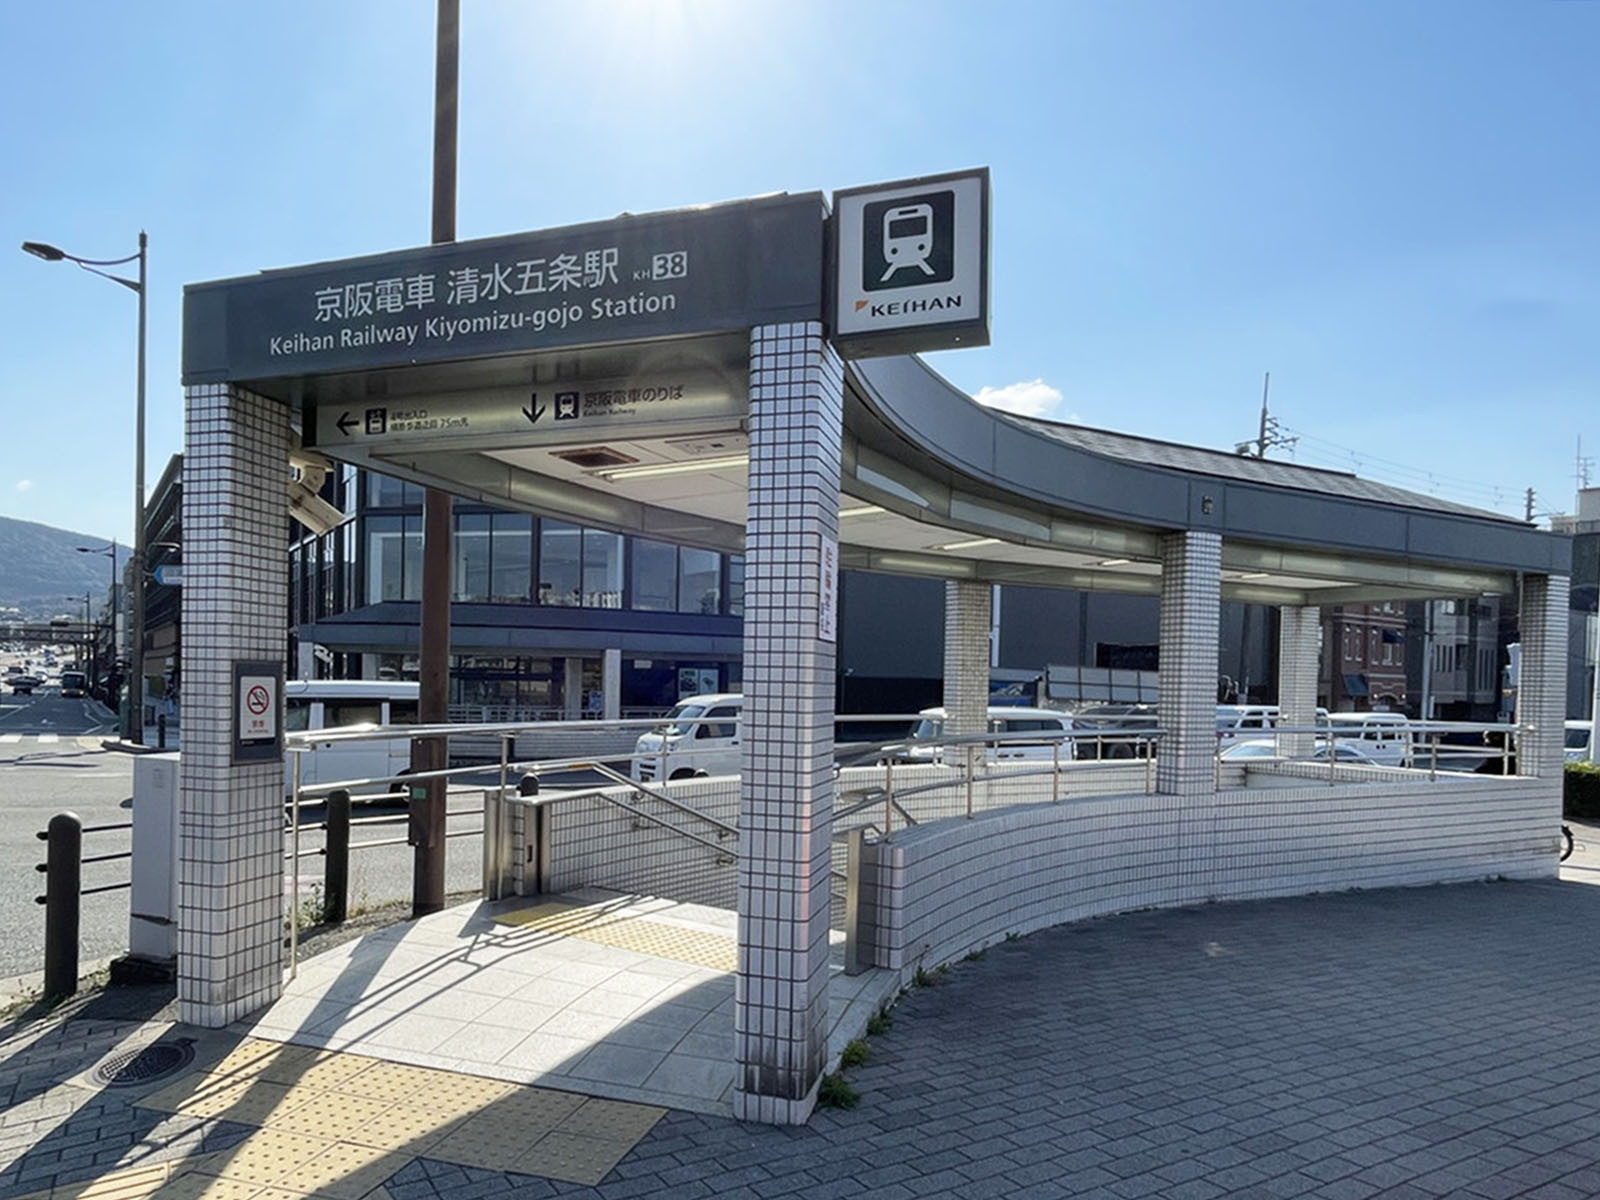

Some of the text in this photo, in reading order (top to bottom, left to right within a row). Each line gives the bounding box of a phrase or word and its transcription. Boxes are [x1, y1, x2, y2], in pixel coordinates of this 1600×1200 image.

[314, 275, 435, 323] 京阪電車
[446, 247, 619, 305] 清水五条駅
[655, 253, 685, 278] 38
[871, 295, 962, 317] KEIHAN
[270, 290, 677, 356] Keihan Railway Kiyomizu-gojo Station
